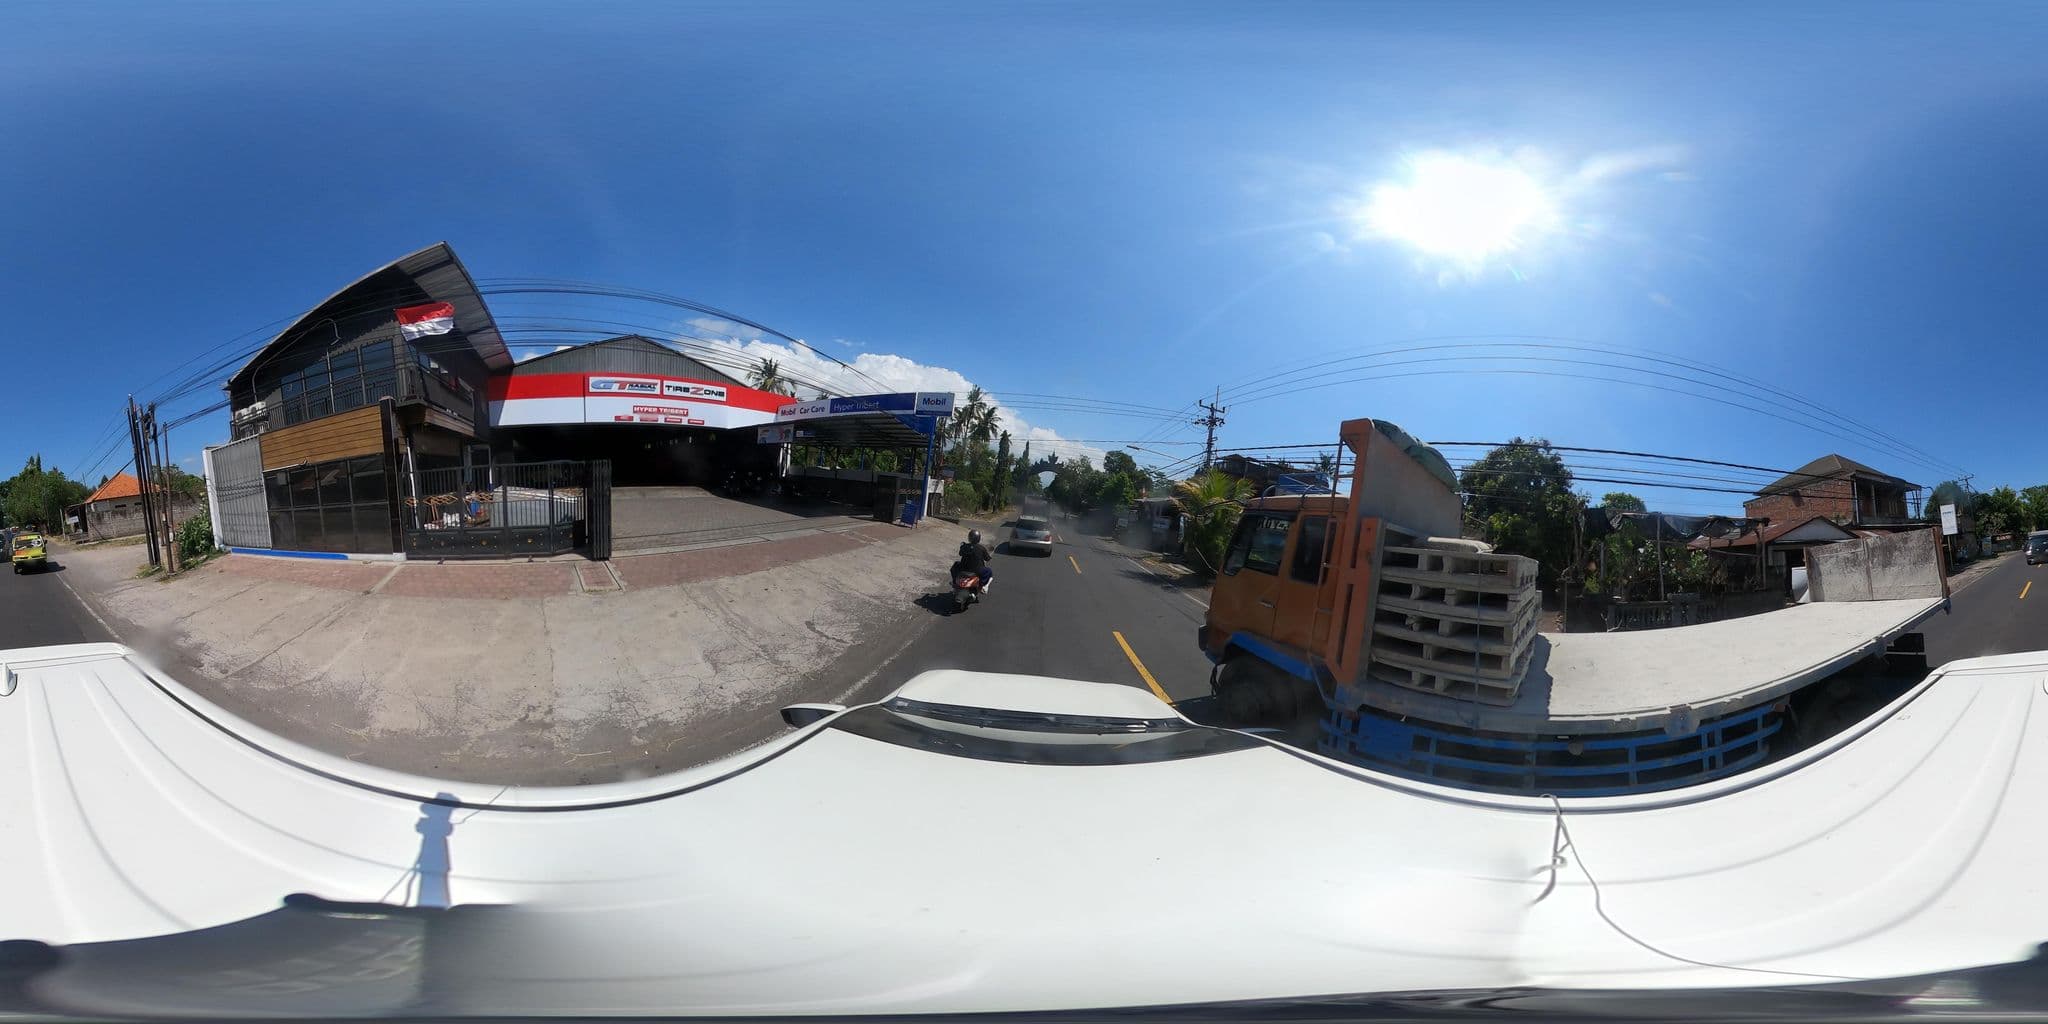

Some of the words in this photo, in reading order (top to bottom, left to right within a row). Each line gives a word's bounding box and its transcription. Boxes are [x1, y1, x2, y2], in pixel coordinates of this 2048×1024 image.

[922, 397, 947, 406] Mobil
[780, 407, 796, 416] Mobil
[799, 407, 810, 415] Car
[811, 405, 826, 413] Care
